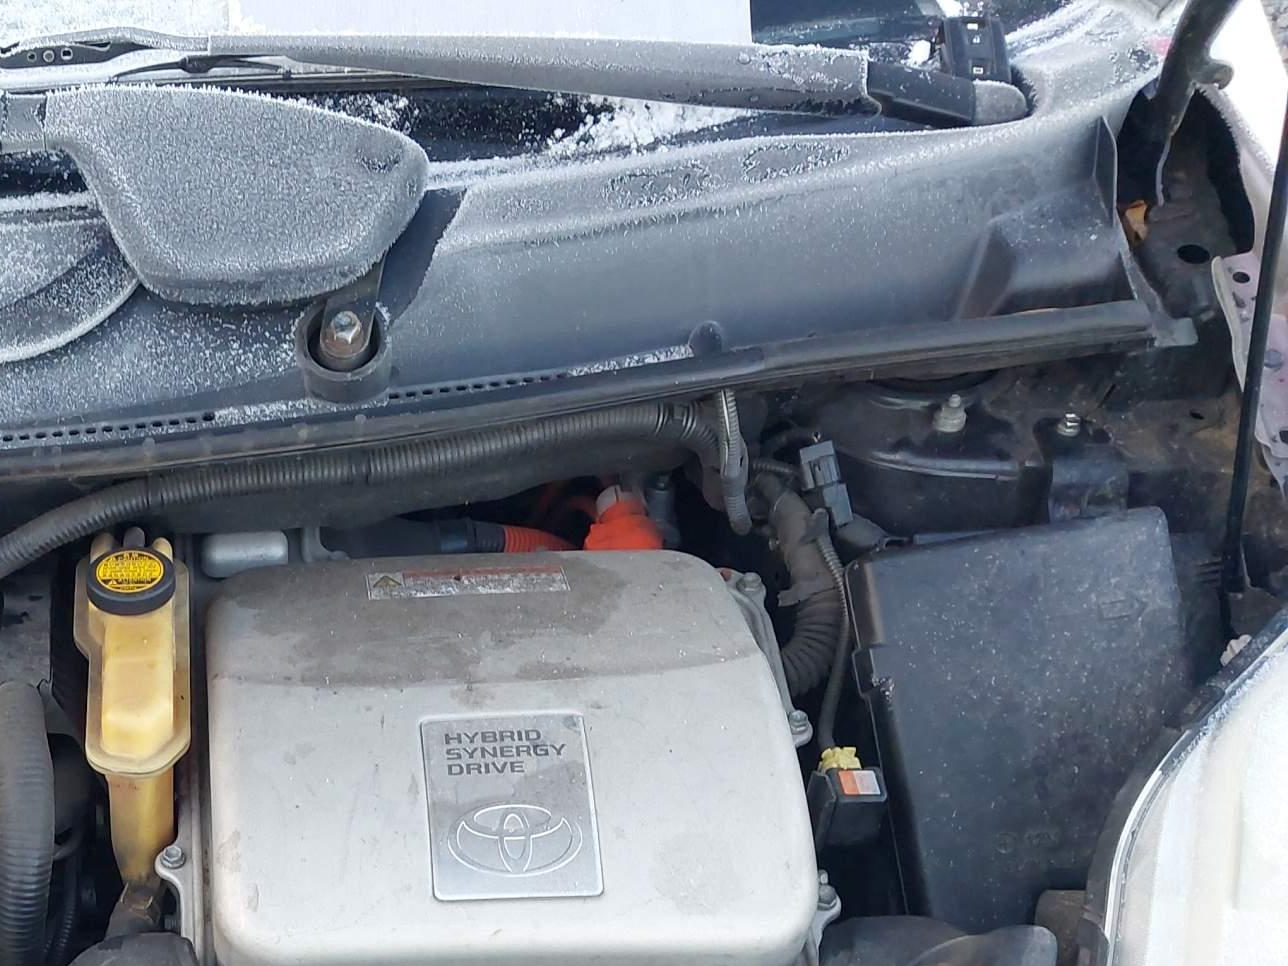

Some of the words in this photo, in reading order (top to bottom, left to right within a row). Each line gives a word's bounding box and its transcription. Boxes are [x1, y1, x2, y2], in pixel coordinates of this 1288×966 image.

[444, 729, 541, 745] HYBRID
[445, 743, 566, 760] SYNERGY
[447, 760, 525, 776] DRIVE
